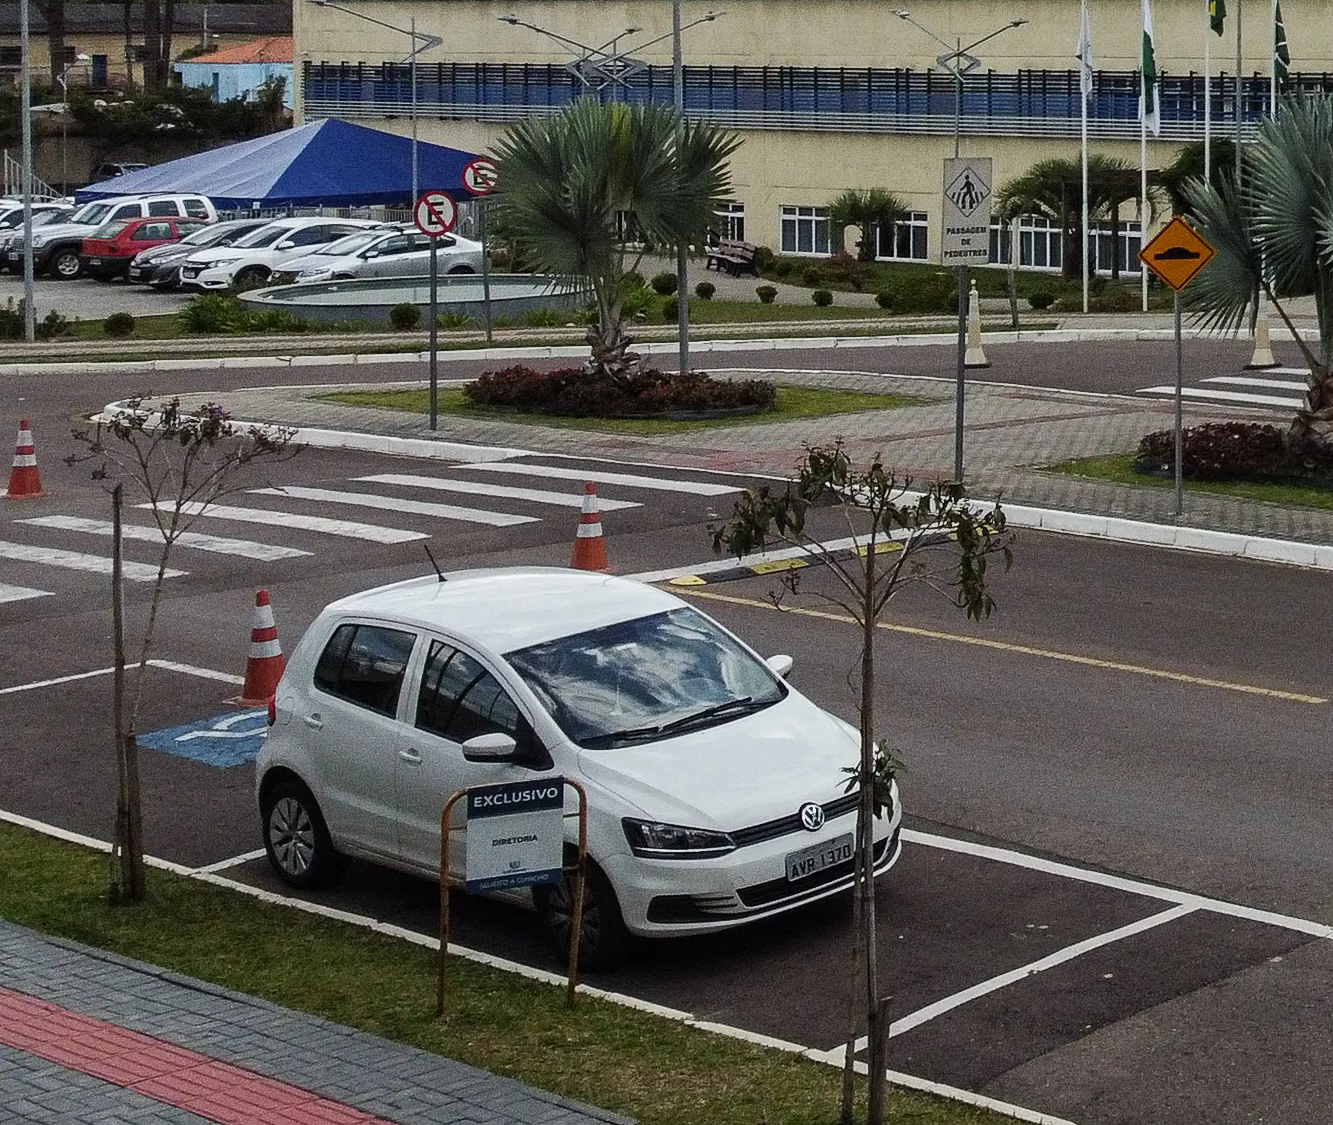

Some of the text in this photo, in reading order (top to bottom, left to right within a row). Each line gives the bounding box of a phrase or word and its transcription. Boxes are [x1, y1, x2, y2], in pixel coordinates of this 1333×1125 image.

[946, 226, 987, 235] PASSAGEM
[961, 238, 971, 246] DE
[944, 249, 988, 258] PEDESTRES
[473, 787, 559, 808] EXCLUSIVO
[492, 834, 538, 847] DIRETORIA
